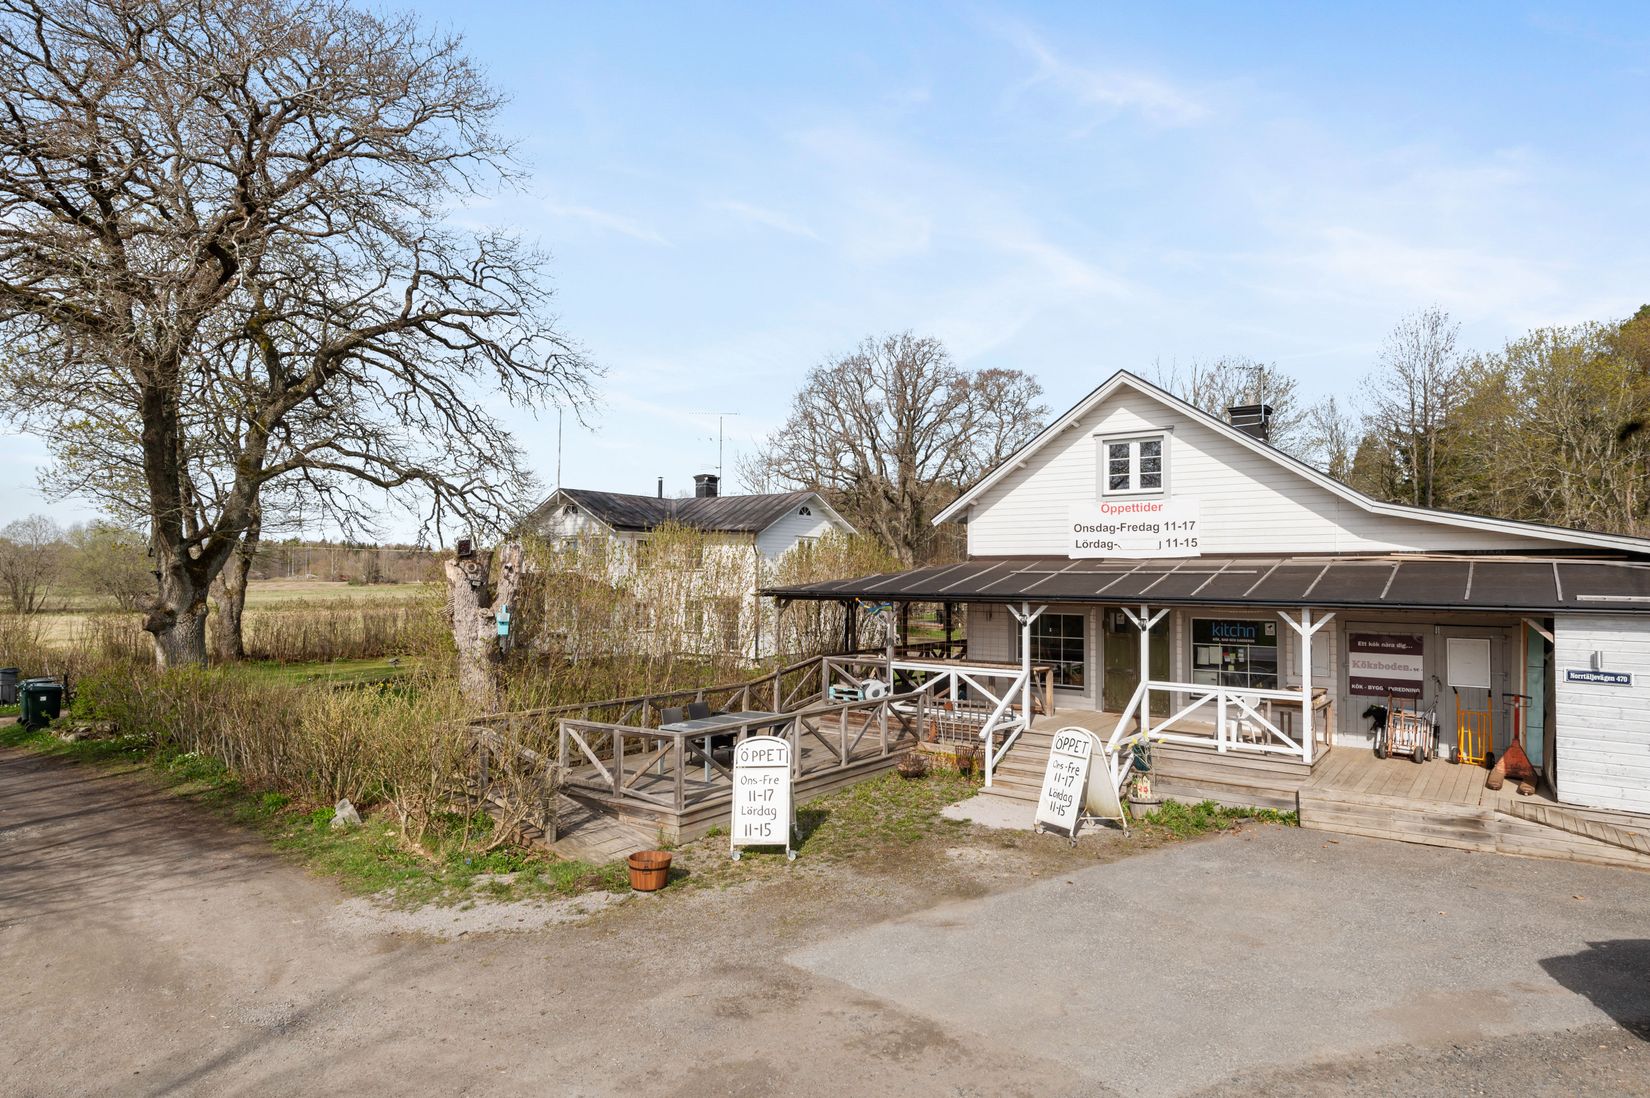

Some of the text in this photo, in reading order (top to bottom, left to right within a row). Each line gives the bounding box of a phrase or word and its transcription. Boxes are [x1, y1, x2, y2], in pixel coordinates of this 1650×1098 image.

[1100, 501, 1163, 515] Öppettider
[1073, 520, 1196, 534] Onsdag-Fredag 11-17
[1165, 537, 1198, 548] 11-15
[1212, 622, 1255, 637] kitchn
[1056, 736, 1089, 754] ÖPPET
[740, 747, 786, 762] ÖPPET
[740, 774, 780, 786] Ons-Fre
[1053, 772, 1075, 788] 11-17
[748, 788, 775, 802] 11-17
[1049, 787, 1073, 807] Lördag
[741, 804, 777, 821] Lördag
[1049, 800, 1067, 817] 11-15
[744, 822, 772, 837] 11-15
